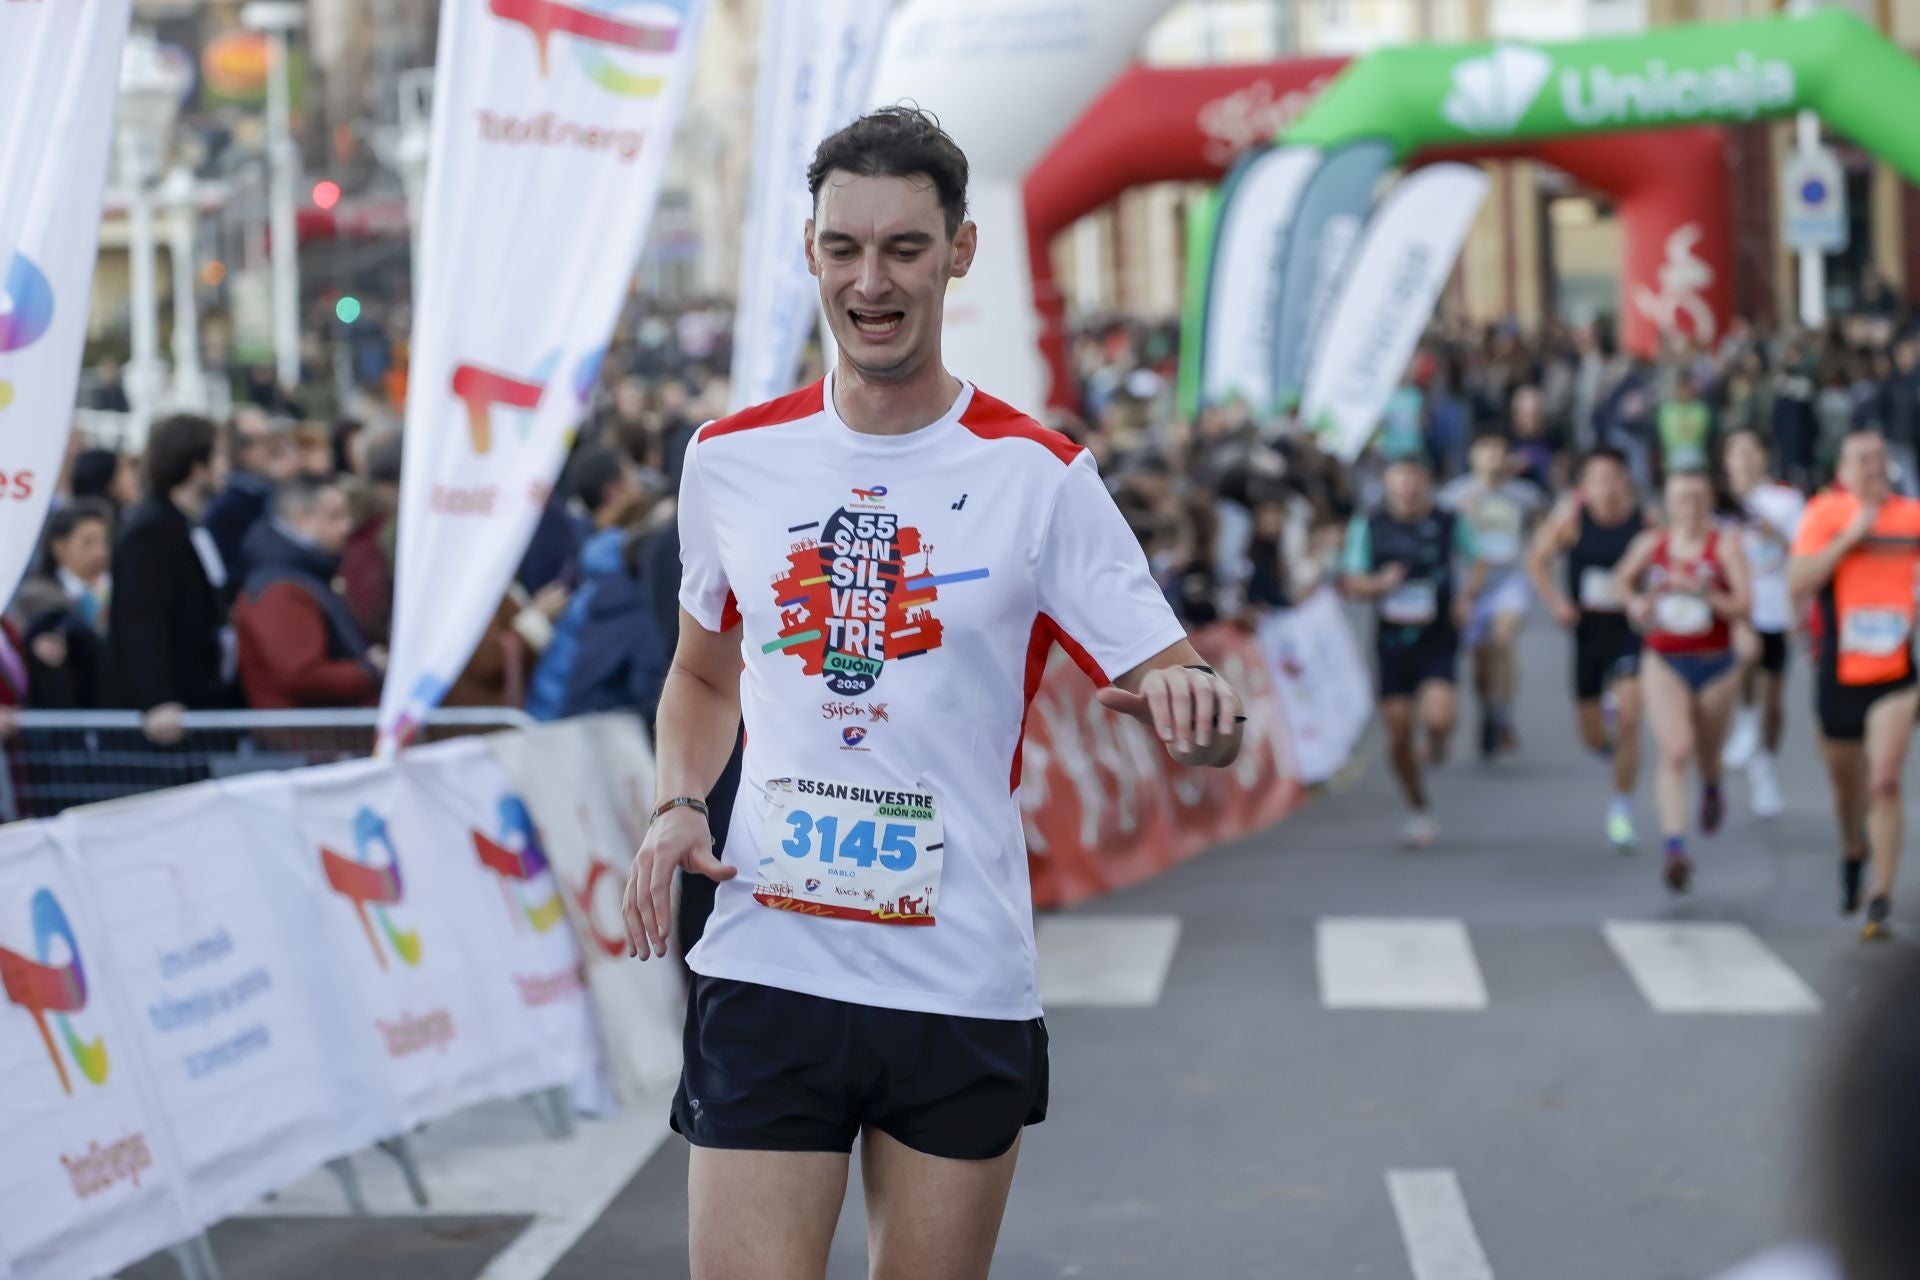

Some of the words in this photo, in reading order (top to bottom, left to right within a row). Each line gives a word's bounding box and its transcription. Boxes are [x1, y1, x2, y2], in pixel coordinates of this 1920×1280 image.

[1560, 48, 1794, 126] Unicaja
[855, 514, 896, 540] 55
[832, 528, 891, 562] SAN
[831, 556, 887, 589] SIL
[830, 588, 887, 620] VES
[824, 616, 886, 662] TRE
[831, 656, 875, 674] GIJÓN
[836, 679, 867, 690] 2024
[798, 778, 815, 794] 55
[815, 782, 848, 800] SAN
[850, 788, 933, 809] SILVESTRE
[879, 806, 909, 818] GIJÓN
[910, 808, 933, 819] 2024
[781, 809, 917, 872] 3145
[828, 868, 856, 878] PABLO
